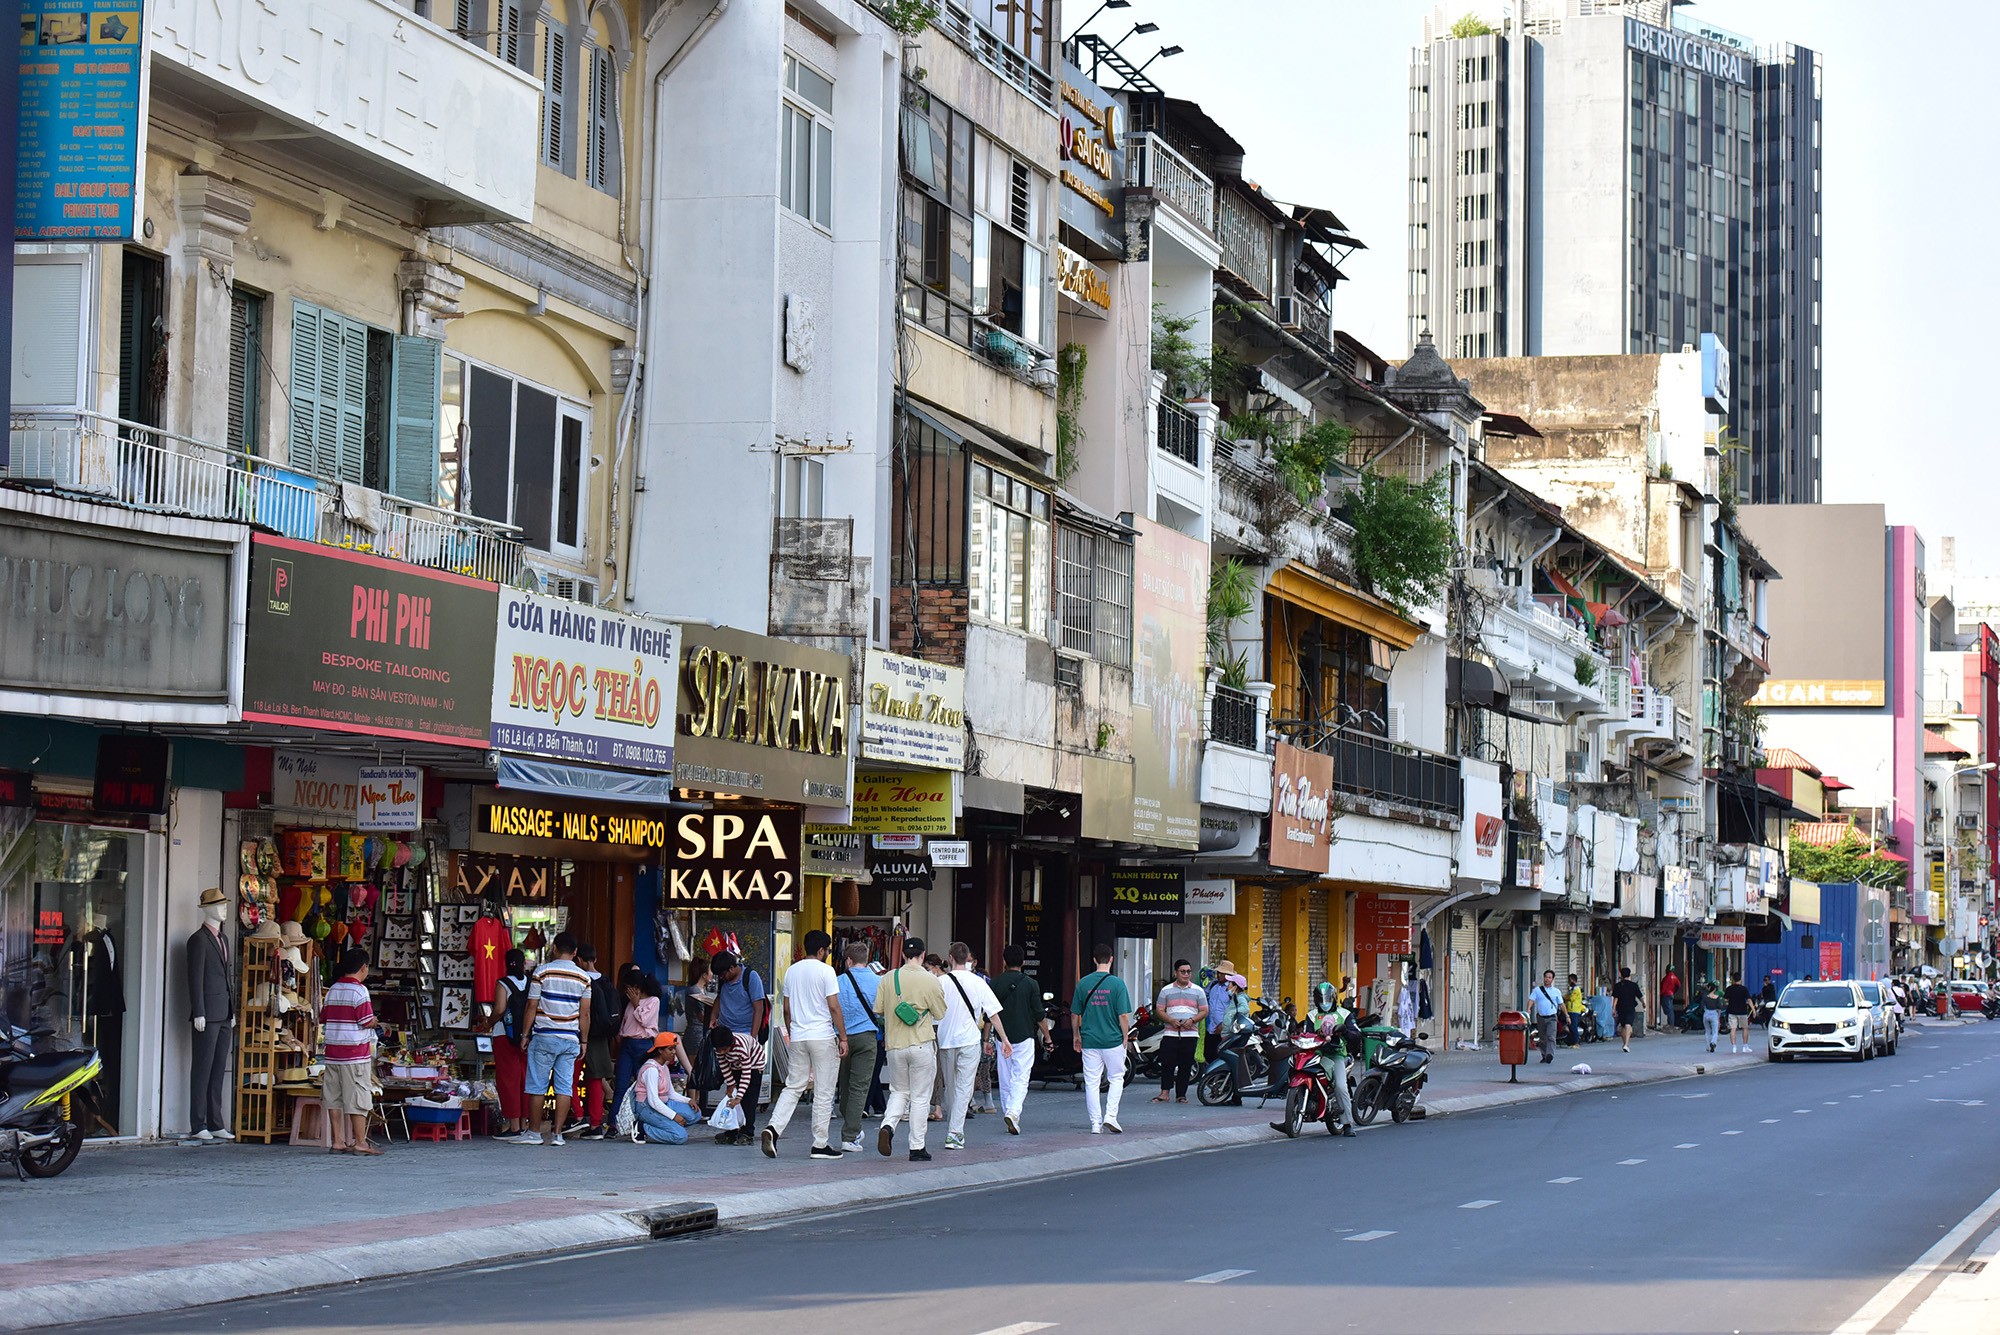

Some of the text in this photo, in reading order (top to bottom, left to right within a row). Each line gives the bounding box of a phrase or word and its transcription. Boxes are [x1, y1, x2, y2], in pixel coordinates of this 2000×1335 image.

[54, 183, 130, 197] DAILY GROUP TOUR
[63, 204, 119, 218] PRIVATE TOUR
[38, 226, 91, 236] AIRPORT
[94, 226, 120, 236] TAXI
[270, 600, 290, 612] TAILOR
[508, 594, 672, 664] CỬA HÀNG MỸ NGHỆ
[322, 652, 450, 683] BESPOKE TAILORING
[901, 662, 916, 676] Tranh
[509, 652, 662, 729] NGỌC THẢO
[912, 680, 925, 691] Gallery
[312, 680, 330, 694] MAY
[352, 684, 369, 698] BÁN
[388, 691, 420, 706] VESTON
[420, 693, 437, 708] NAM
[685, 644, 848, 758] SPA KAKA
[254, 701, 263, 710] 118
[264, 702, 271, 711] Le
[291, 705, 302, 714] Ben
[303, 706, 319, 716] Thanh
[355, 711, 370, 723] Mobile
[375, 715, 383, 724] +84
[497, 728, 666, 764] 116 Lê Lợi, P. Bến Thành, Q.1 ĐT: 0908.103.765
[360, 769, 416, 779] Handicrafts Article Shop
[863, 776, 903, 784] Gallery
[361, 780, 415, 820] Ngoc Thao
[890, 786, 945, 802] Hoa
[491, 804, 665, 848] MASSAGE NAILS SHAMPOO
[677, 813, 787, 860] SPA
[872, 863, 928, 874] ALUVIA
[1140, 871, 1160, 879] THÊU
[669, 868, 794, 901] KAKA2
[1113, 887, 1179, 903] XQ SÀI GÒN
[1370, 916, 1394, 924] TEA
[1378, 929, 1384, 937] &
[1356, 943, 1406, 952] COFFEE
